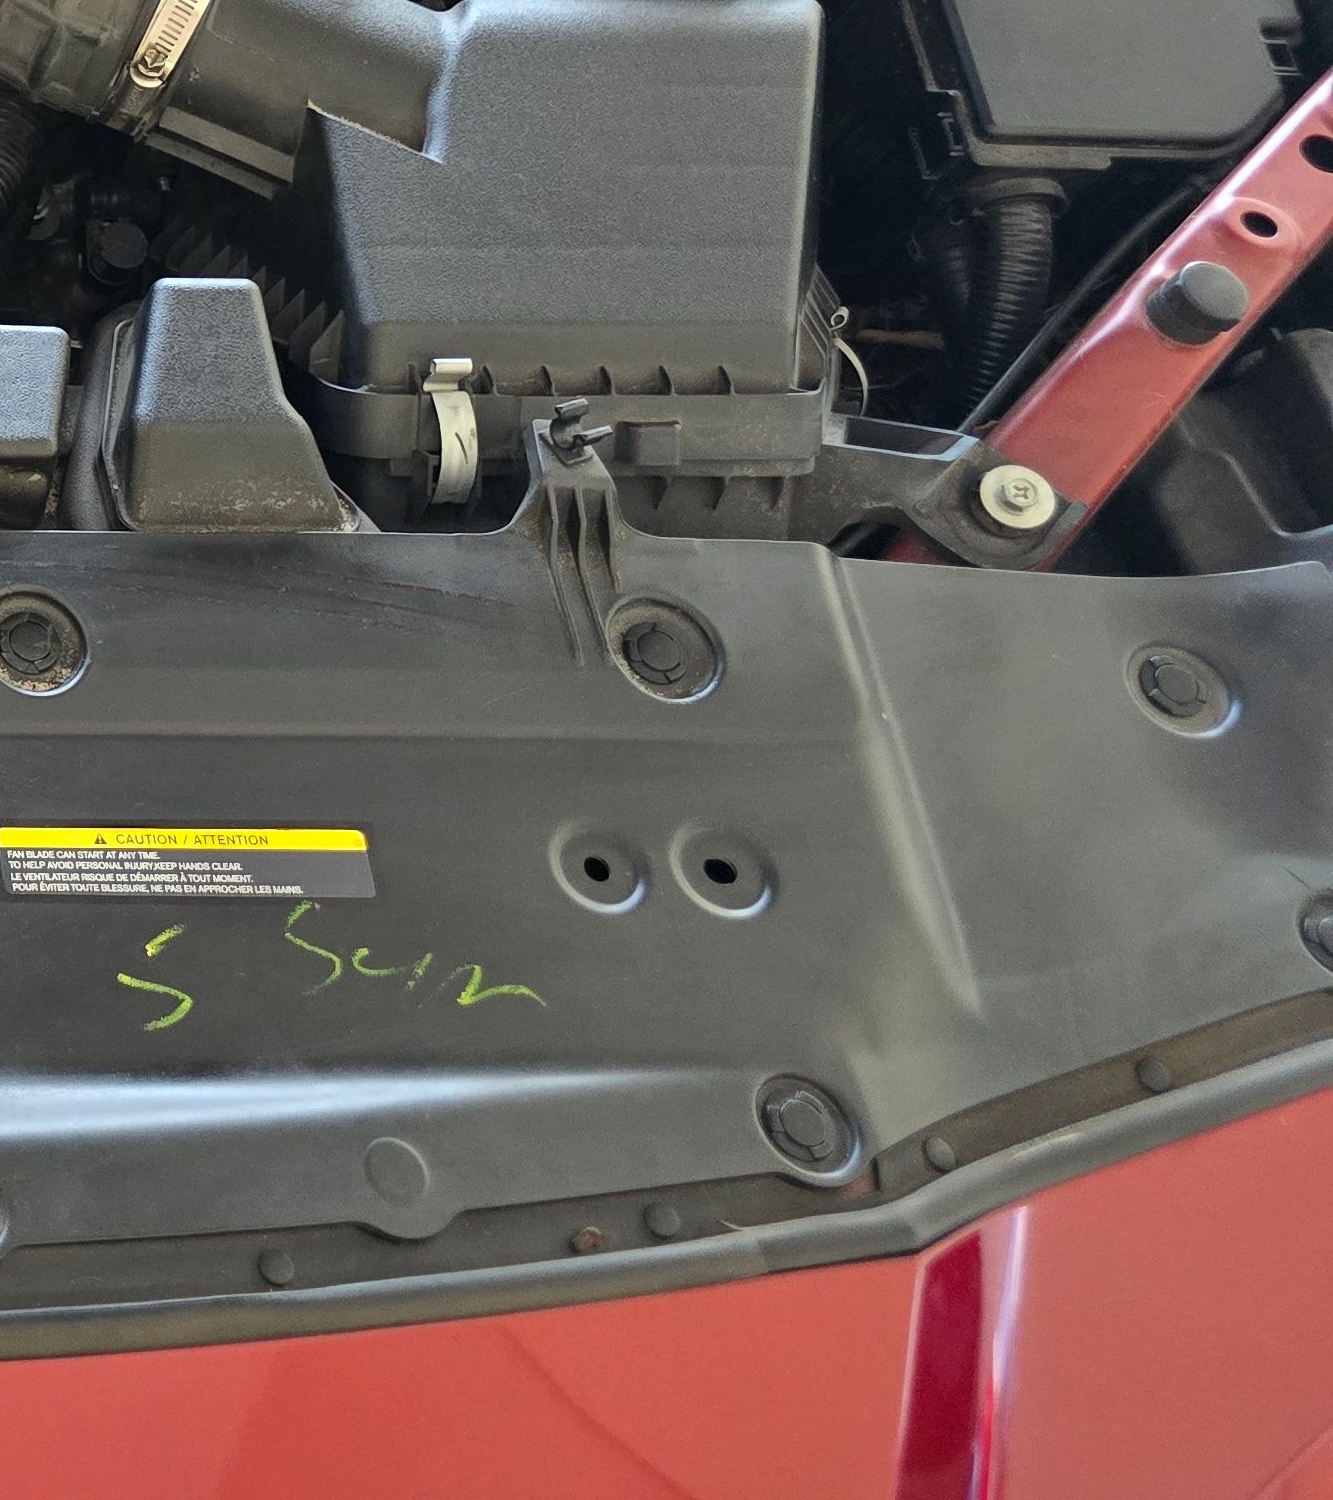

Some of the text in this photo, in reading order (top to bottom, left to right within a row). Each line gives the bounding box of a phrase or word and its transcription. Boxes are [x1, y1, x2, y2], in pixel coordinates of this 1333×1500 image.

[116, 833, 178, 845] CAUTION
[193, 834, 269, 846] ATTENTION
[7, 850, 161, 860] FAN BLADE CAN START AT ANY TIME.
[8, 860, 22, 869] TO
[22, 860, 46, 869] HELP
[47, 861, 75, 870] AVOID
[75, 861, 123, 870] PERSONAL
[178, 862, 210, 871] HANDS
[211, 862, 244, 871] CLEAR.
[10, 871, 254, 883] LE VENTILATEUR RISQUE DE DÉMARRER À TOUT MOMENT.
[12, 880, 303, 894] POUR ÉVITER TOUTE BLESSURE, NE PAS EN APPROCHER LES MAINS.
